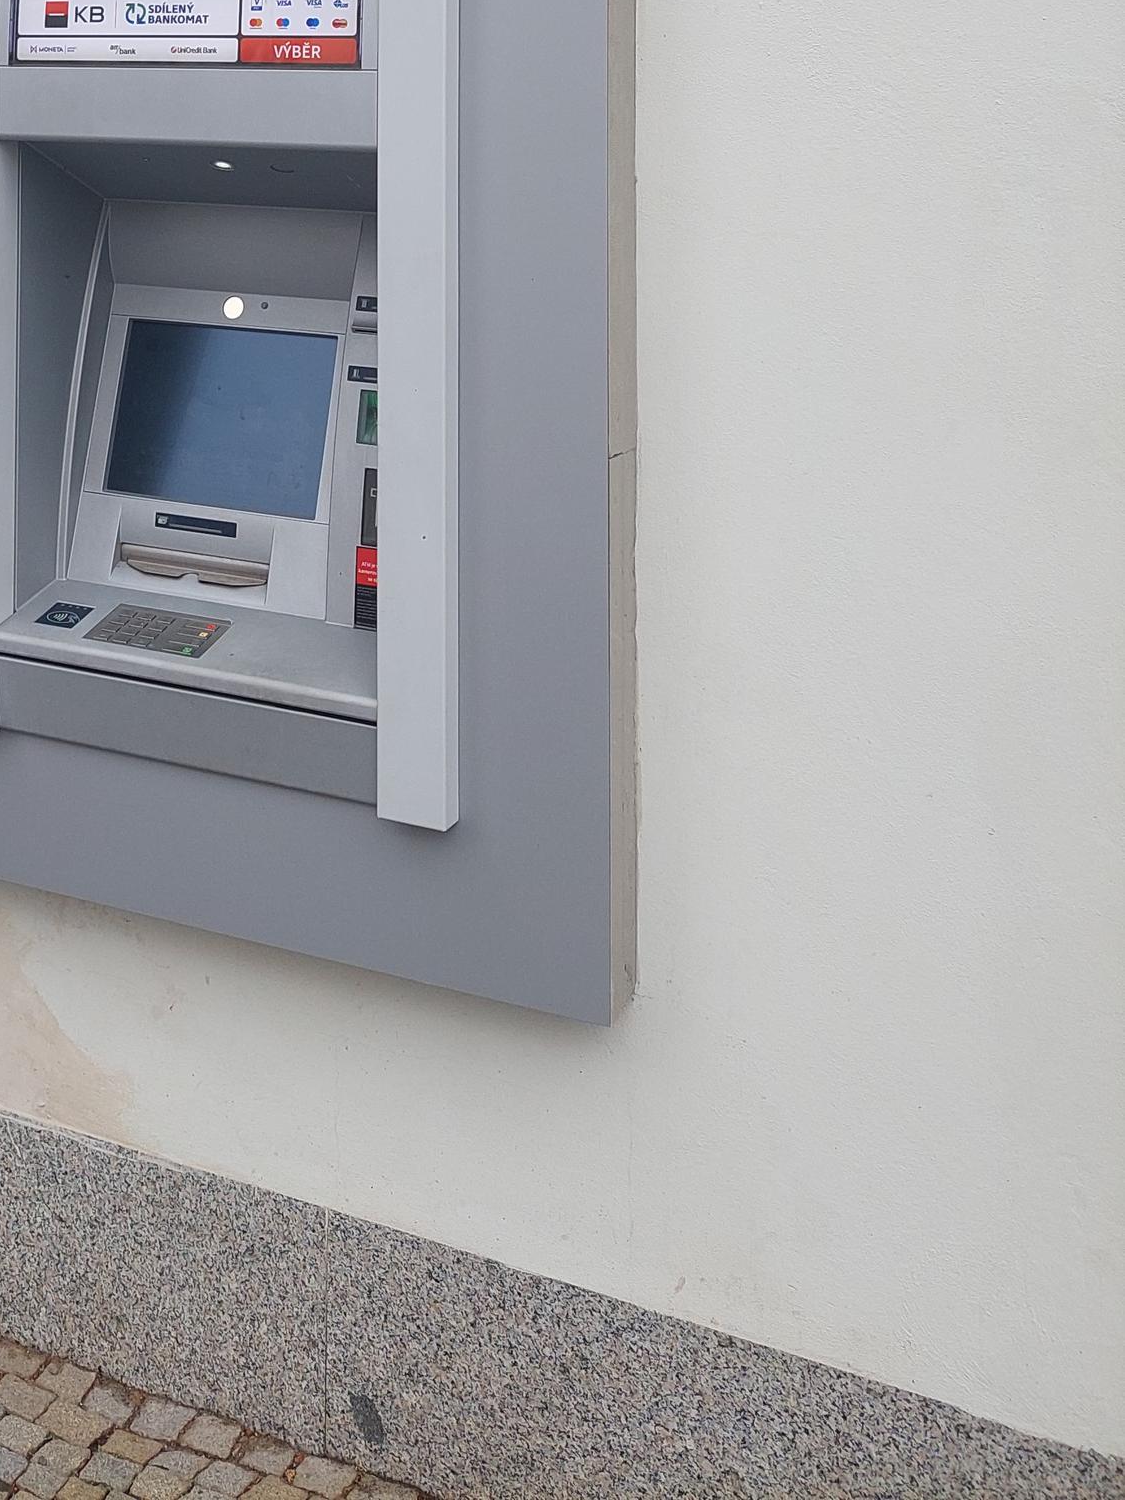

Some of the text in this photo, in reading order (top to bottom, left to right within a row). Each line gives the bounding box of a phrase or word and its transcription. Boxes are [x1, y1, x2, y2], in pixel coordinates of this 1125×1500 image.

[148, 1, 195, 14] SDÍLENÝ
[74, 6, 105, 23] KB
[148, 14, 210, 25] BANKOMAT
[119, 47, 136, 55] bank
[177, 46, 218, 54] UniCredit Bank
[273, 40, 321, 59] VÝBĚR
